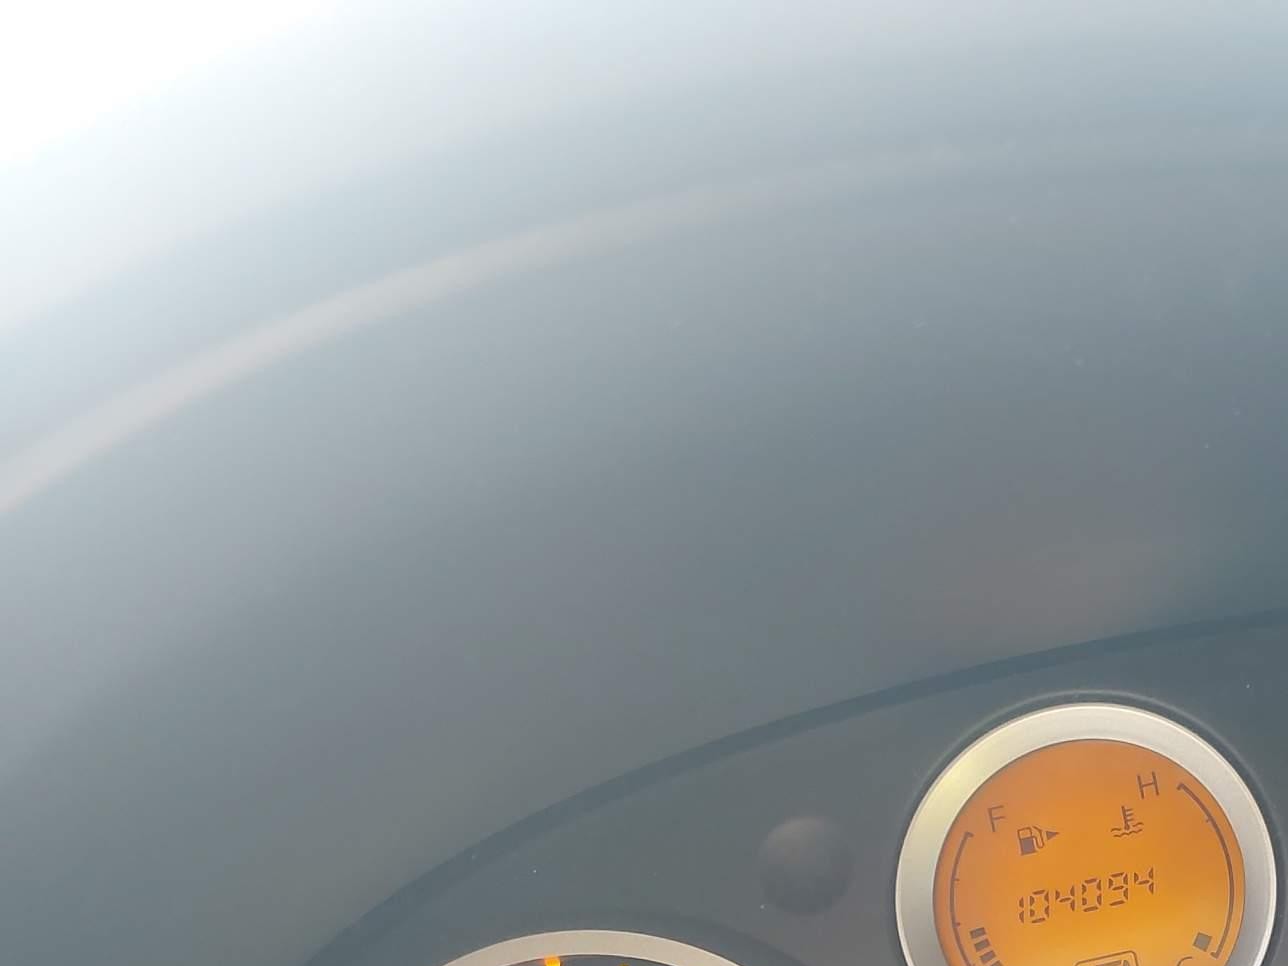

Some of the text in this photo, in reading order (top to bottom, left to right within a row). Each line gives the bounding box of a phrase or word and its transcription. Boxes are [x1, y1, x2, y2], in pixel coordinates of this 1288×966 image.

[1136, 771, 1160, 800] H
[987, 805, 1006, 833] F
[1018, 867, 1155, 924] 104094
